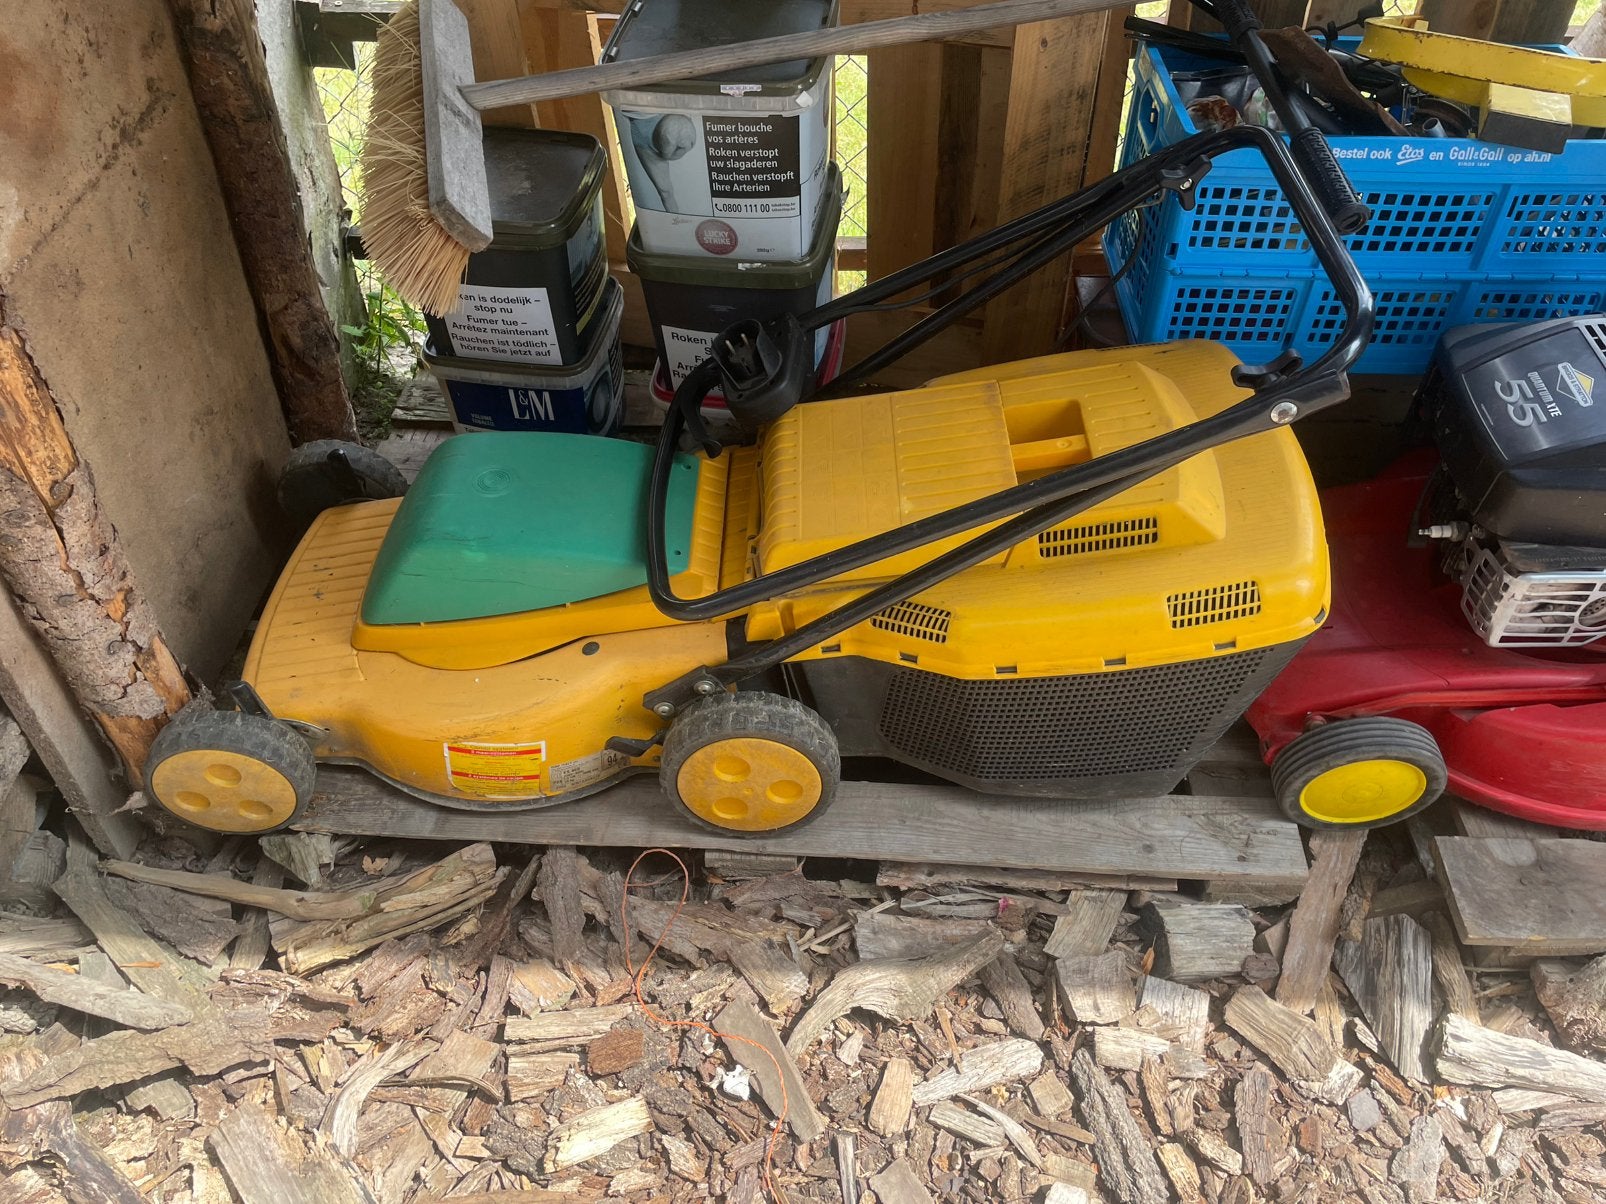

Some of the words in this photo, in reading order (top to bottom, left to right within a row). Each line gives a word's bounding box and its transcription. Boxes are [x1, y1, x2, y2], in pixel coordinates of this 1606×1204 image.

[706, 122, 736, 131] Fumer
[738, 122, 773, 132] bouche
[725, 134, 758, 143] artères
[709, 147, 738, 156] Roken
[740, 148, 778, 158] verstopt
[1332, 147, 1368, 158] Bestel
[1370, 148, 1392, 159] ook
[1397, 144, 1424, 162] Etos
[1429, 150, 1444, 160] en
[1450, 146, 1504, 160] Gall&Gall
[1507, 153, 1522, 164] op
[1524, 151, 1551, 162] ah.nl
[726, 159, 778, 170] slagaderen
[711, 171, 750, 180] Rauchen
[752, 171, 794, 182] verstopft
[712, 182, 730, 191] Ihre
[732, 183, 770, 191] Arterien
[722, 203, 742, 212] 0800
[745, 204, 758, 212] 111
[760, 203, 770, 212] 00
[704, 230, 729, 238] LUCKY
[703, 237, 730, 245] STRIKE
[478, 294, 487, 302] is
[490, 295, 531, 306] dodelijk
[474, 305, 497, 314] stop
[466, 315, 498, 325] Fumer
[501, 318, 519, 326] tue
[452, 322, 488, 334] Arrêtez
[490, 328, 549, 336] maintenant
[451, 332, 495, 345] Rauchen
[498, 337, 511, 346] ist
[512, 339, 547, 348] tödlich
[671, 332, 707, 344] Roken
[460, 343, 489, 353] hören
[491, 345, 507, 354] Sie
[510, 347, 532, 357] jetzt
[535, 349, 551, 357] auf
[1527, 371, 1554, 403] QUANTUM
[1546, 402, 1562, 418] XTE
[508, 388, 555, 421] L&M
[1494, 380, 1548, 427] 55
[607, 753, 618, 766] 94
